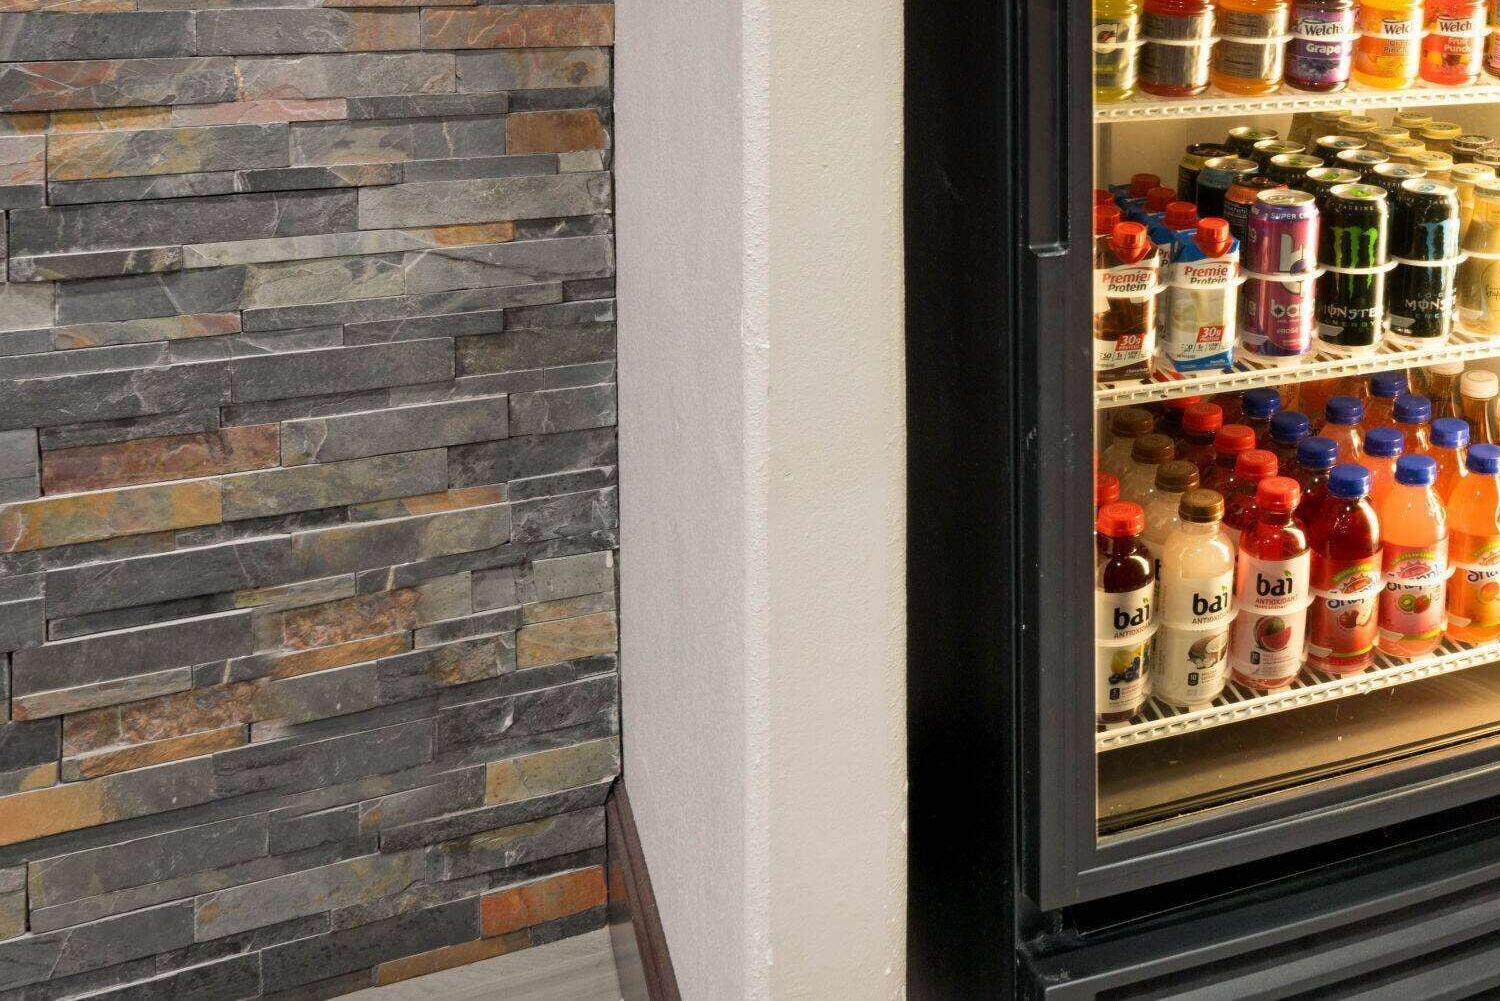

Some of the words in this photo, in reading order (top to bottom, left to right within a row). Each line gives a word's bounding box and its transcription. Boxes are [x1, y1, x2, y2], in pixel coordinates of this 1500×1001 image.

[1306, 43, 1342, 54] Grape
[1271, 211, 1297, 220] SUPER
[1108, 283, 1147, 293] Protein
[1256, 570, 1293, 597] bai
[1193, 586, 1229, 616] bai
[1114, 598, 1150, 630] bai
